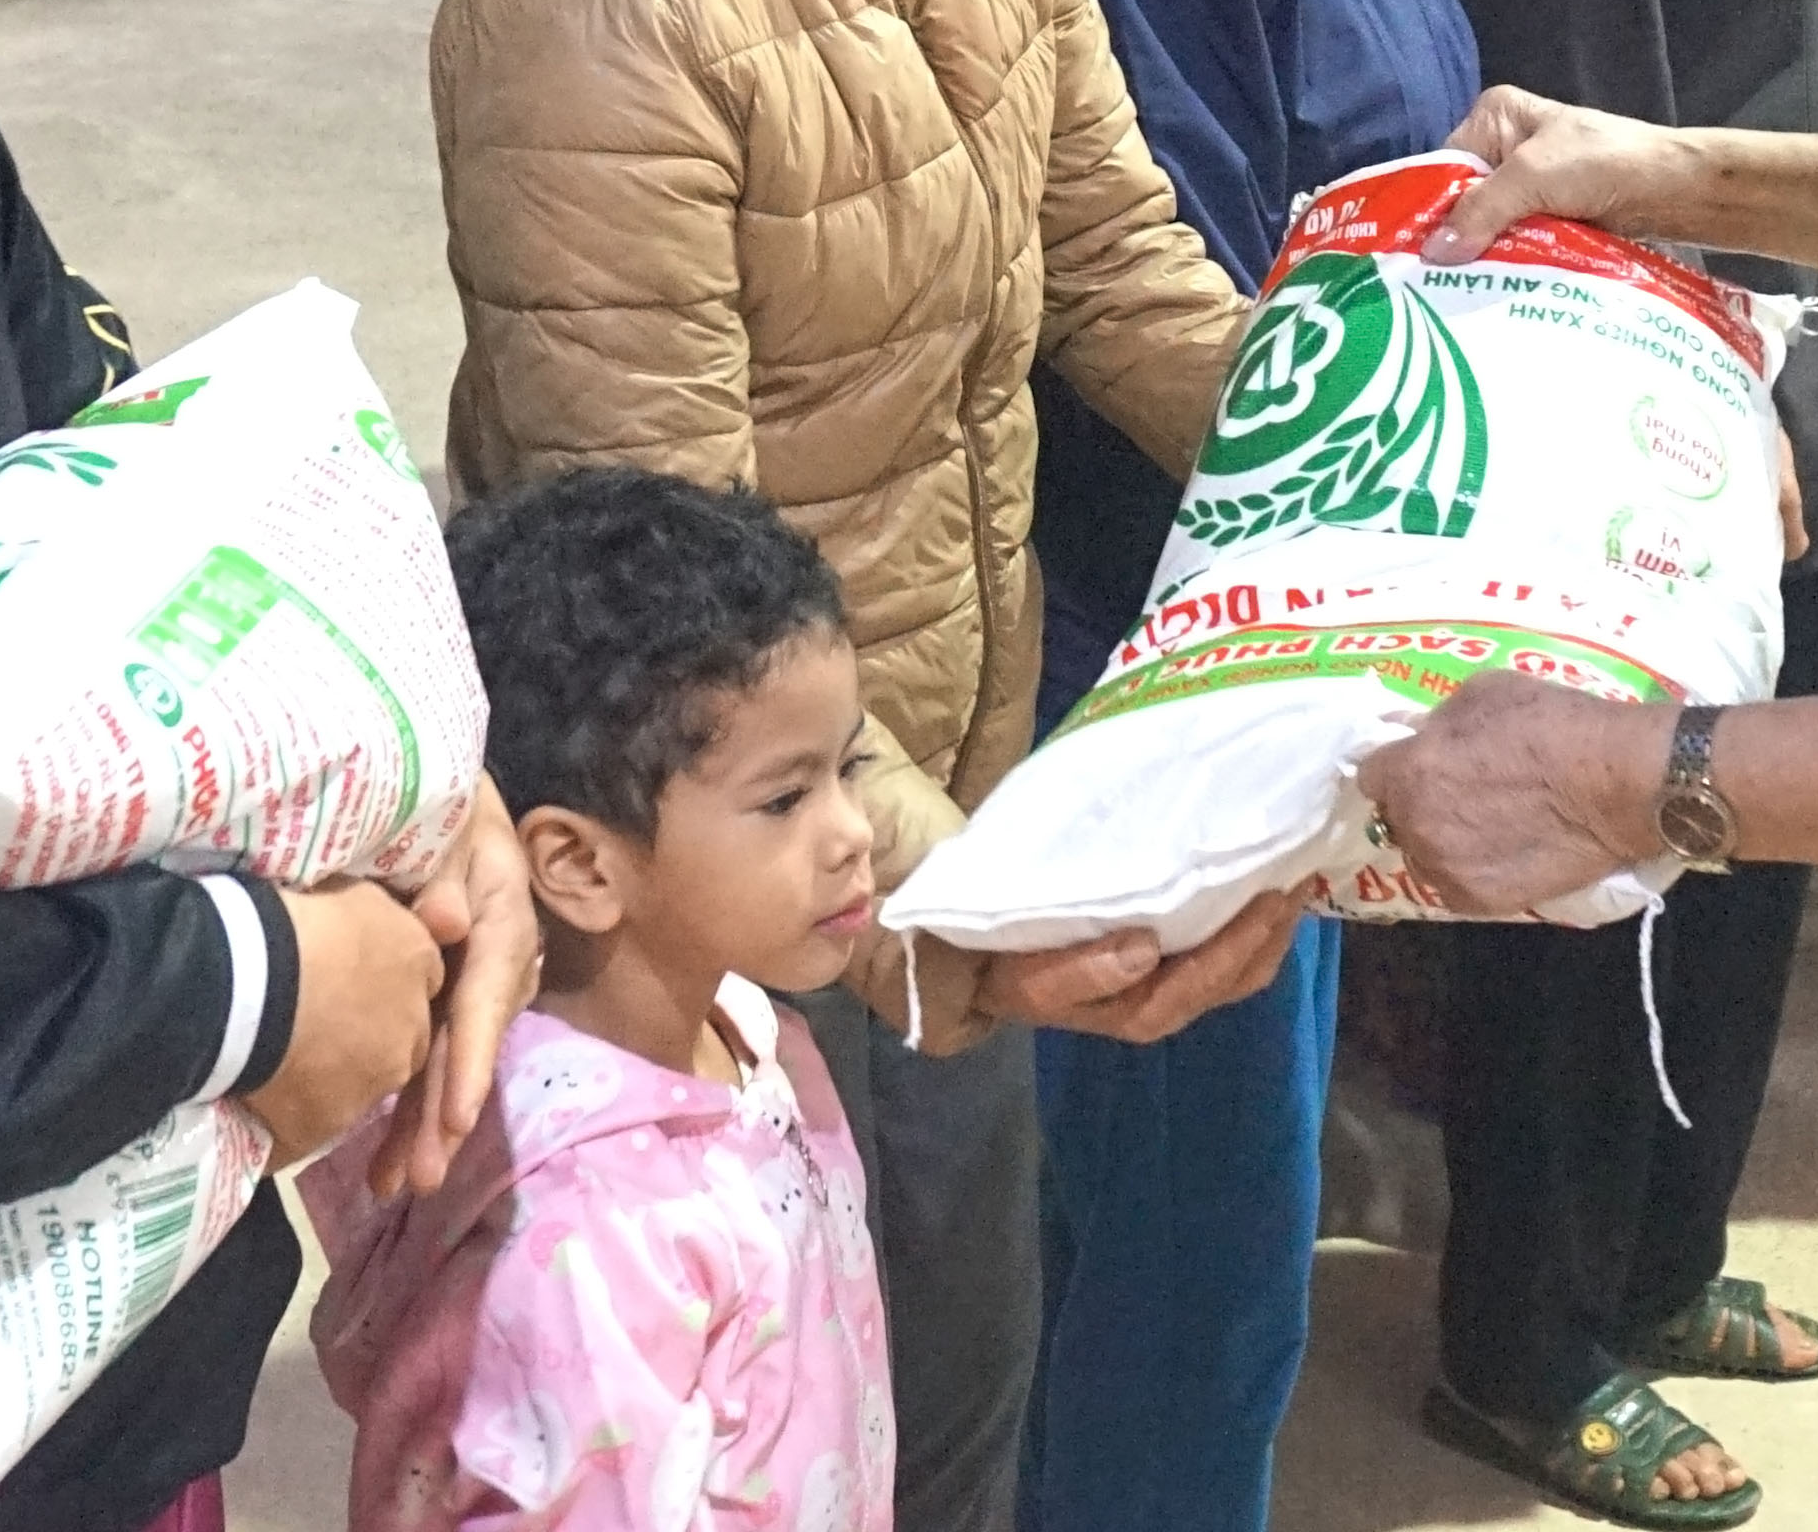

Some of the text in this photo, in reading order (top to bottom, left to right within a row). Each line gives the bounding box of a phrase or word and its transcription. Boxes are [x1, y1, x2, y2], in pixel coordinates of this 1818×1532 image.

[1423, 269, 1492, 295] LÀNH
[1502, 275, 1542, 294] AN
[1508, 302, 1586, 330] XANH
[74, 1219, 104, 1360] HOTLINE
